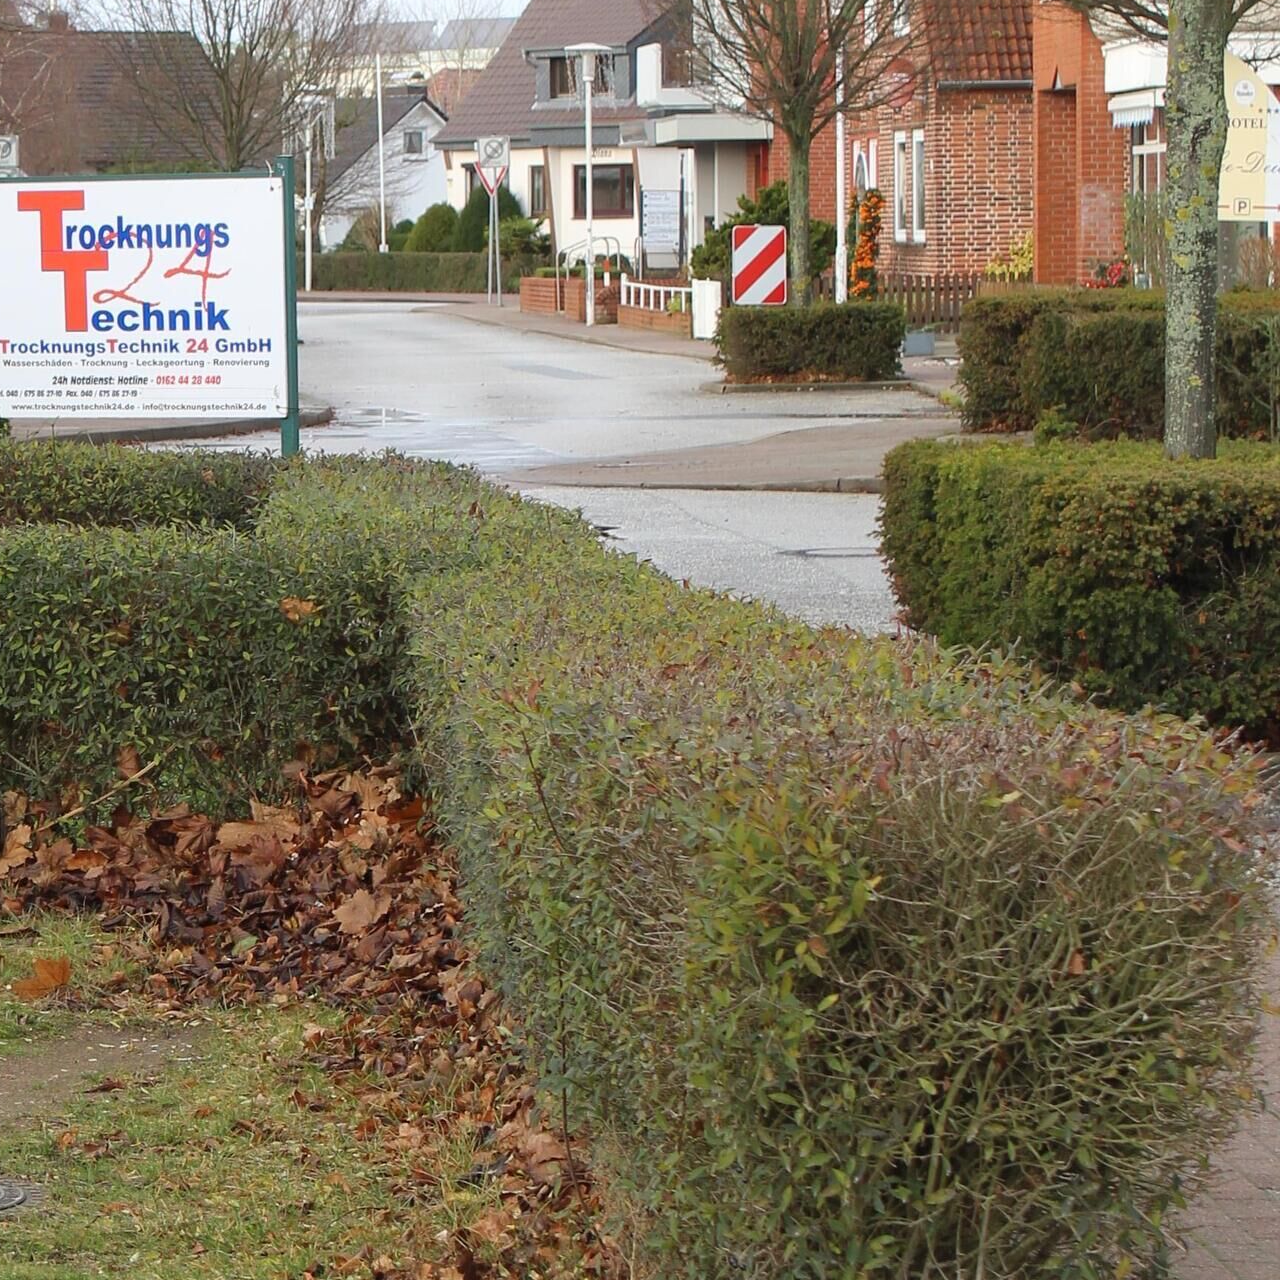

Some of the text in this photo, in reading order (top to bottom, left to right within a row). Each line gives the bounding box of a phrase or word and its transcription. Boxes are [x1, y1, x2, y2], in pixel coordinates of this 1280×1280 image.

[1238, 201, 1247, 213] P
[17, 190, 230, 257] Trocknungs
[41, 251, 231, 332] Technik
[185, 336, 210, 354] 24
[214, 337, 272, 354] GmbH
[2, 359, 73, 368] Wasserschäden
[81, 359, 128, 368] Trocknung
[136, 359, 205, 368] Leckageortung
[213, 359, 270, 368] Renovierung
[52, 375, 68, 385] 24h
[70, 375, 115, 385] Notdienst:
[117, 375, 149, 385] Hotline
[177, 375, 190, 386] 44
[204, 375, 222, 386] 440
[11, 403, 135, 412] www.trocknungstechnik24.de
